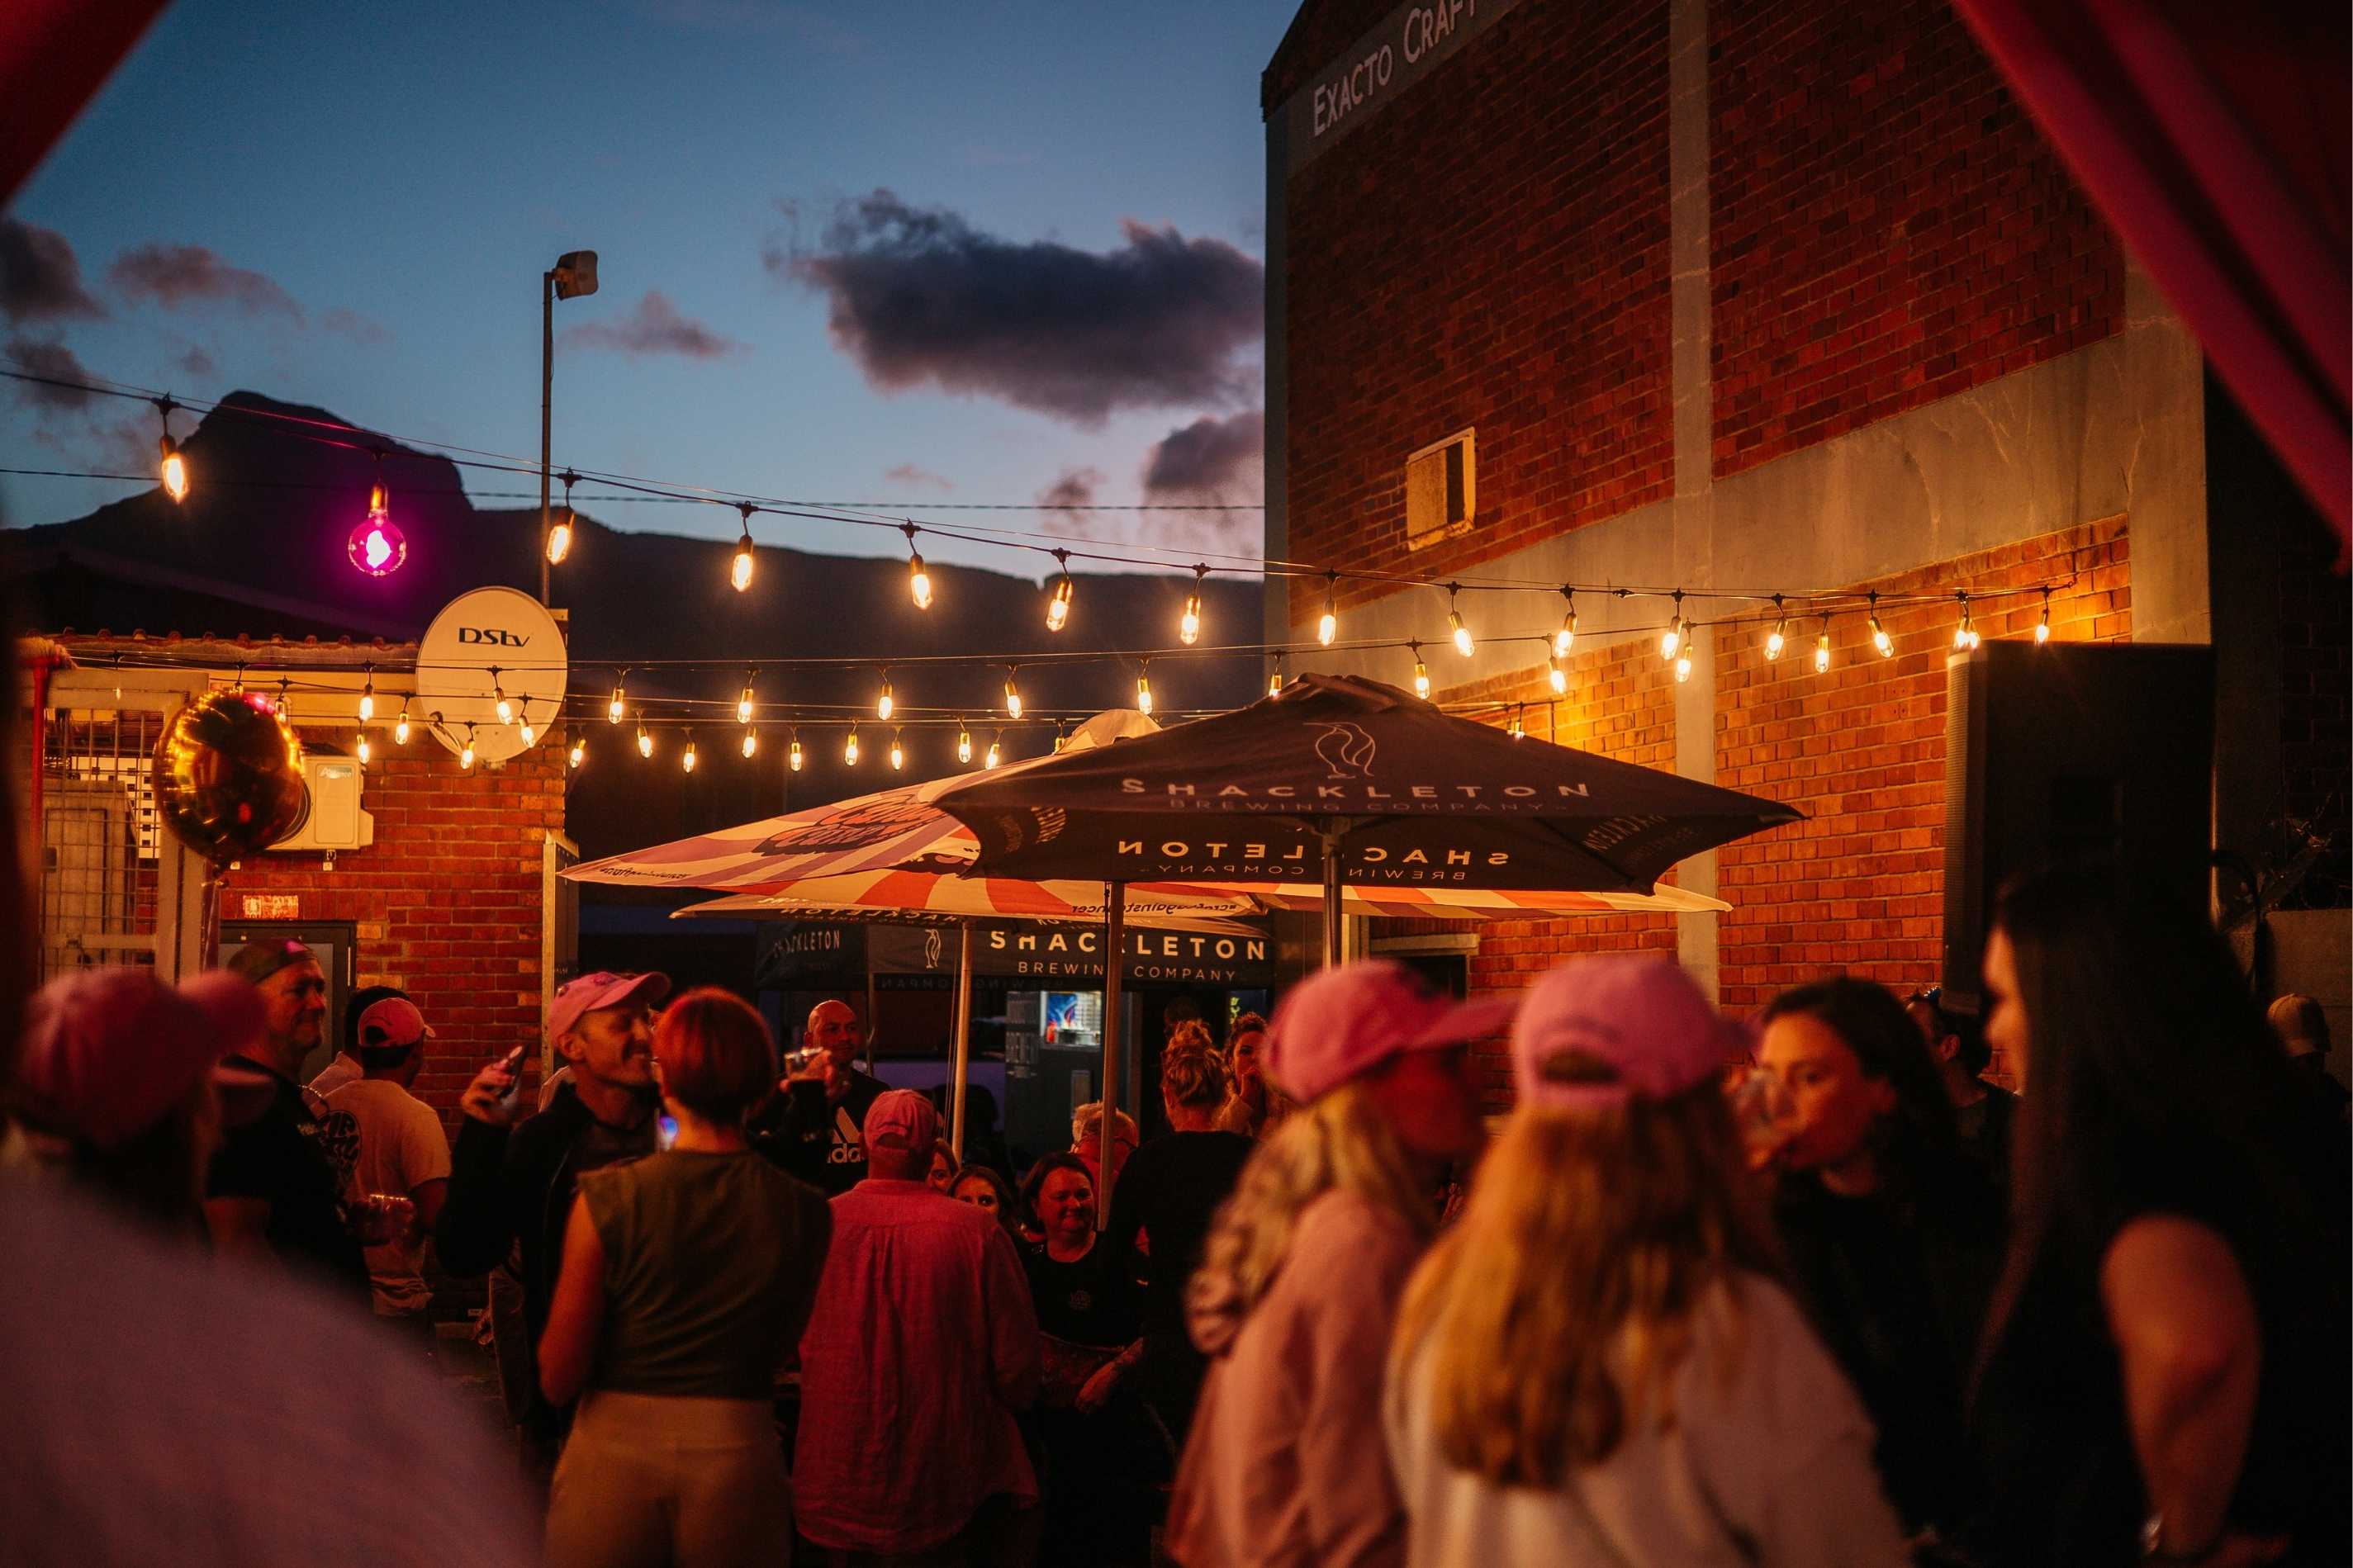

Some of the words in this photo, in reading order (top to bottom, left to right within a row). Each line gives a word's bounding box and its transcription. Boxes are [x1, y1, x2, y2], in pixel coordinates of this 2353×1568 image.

[1312, 44, 1392, 138] EXACTO
[458, 627, 530, 647] DStv
[1121, 778, 1590, 798] SHACKLETON
[1169, 798, 1340, 812] BREWING
[1367, 801, 1544, 812] COMPANY
[990, 930, 1264, 960] SHACLETON
[1018, 961, 1104, 976] BREWIN
[1134, 965, 1236, 981] COMPANY
